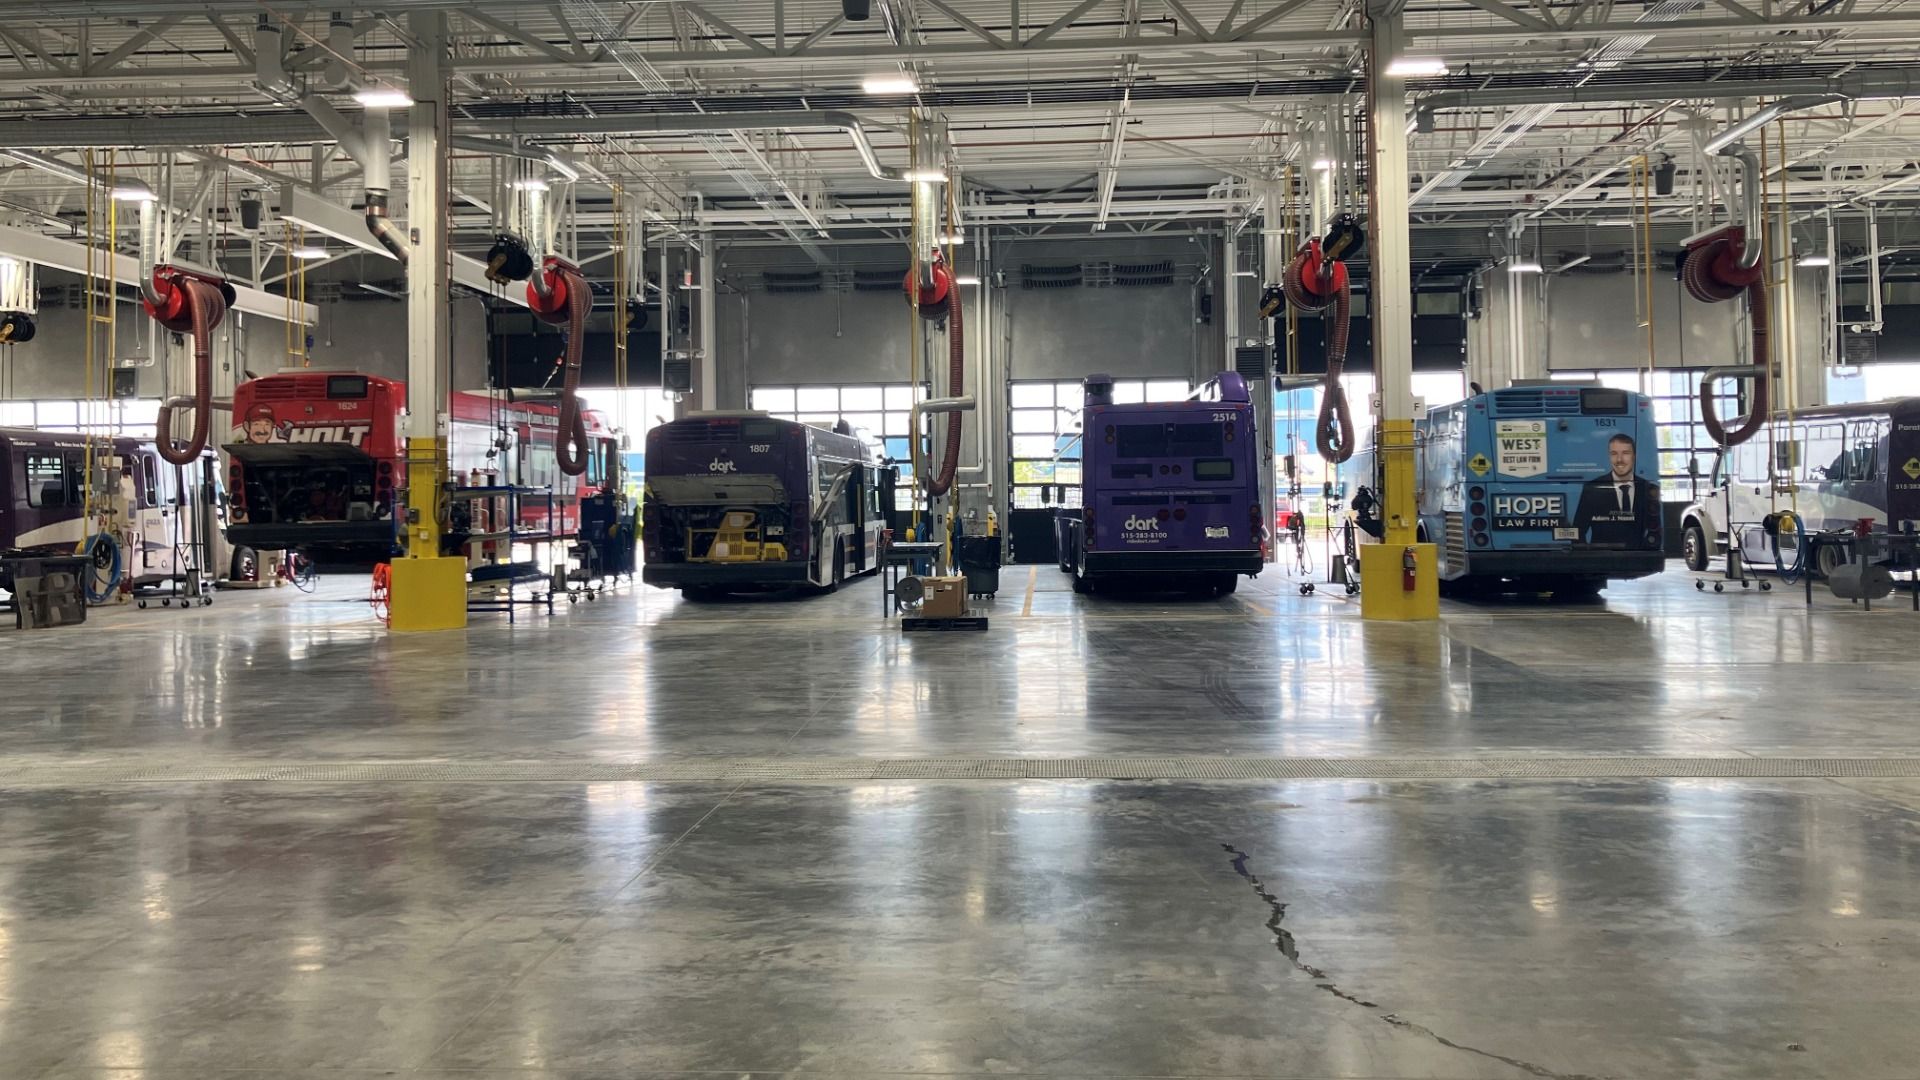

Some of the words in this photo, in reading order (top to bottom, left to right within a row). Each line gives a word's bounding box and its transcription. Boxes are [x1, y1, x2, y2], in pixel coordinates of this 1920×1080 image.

[1373, 400, 1381, 408] G
[1414, 402, 1420, 411] F
[1212, 412, 1237, 422] 2514
[1595, 418, 1617, 427] 1631
[289, 426, 370, 447] HOLT
[749, 444, 770, 453] 1807
[1502, 439, 1541, 450] WEST
[1495, 497, 1561, 515] HOPE
[1124, 514, 1159, 530] dart
[1499, 519, 1525, 527] LAW
[1530, 519, 1559, 527] FIRM
